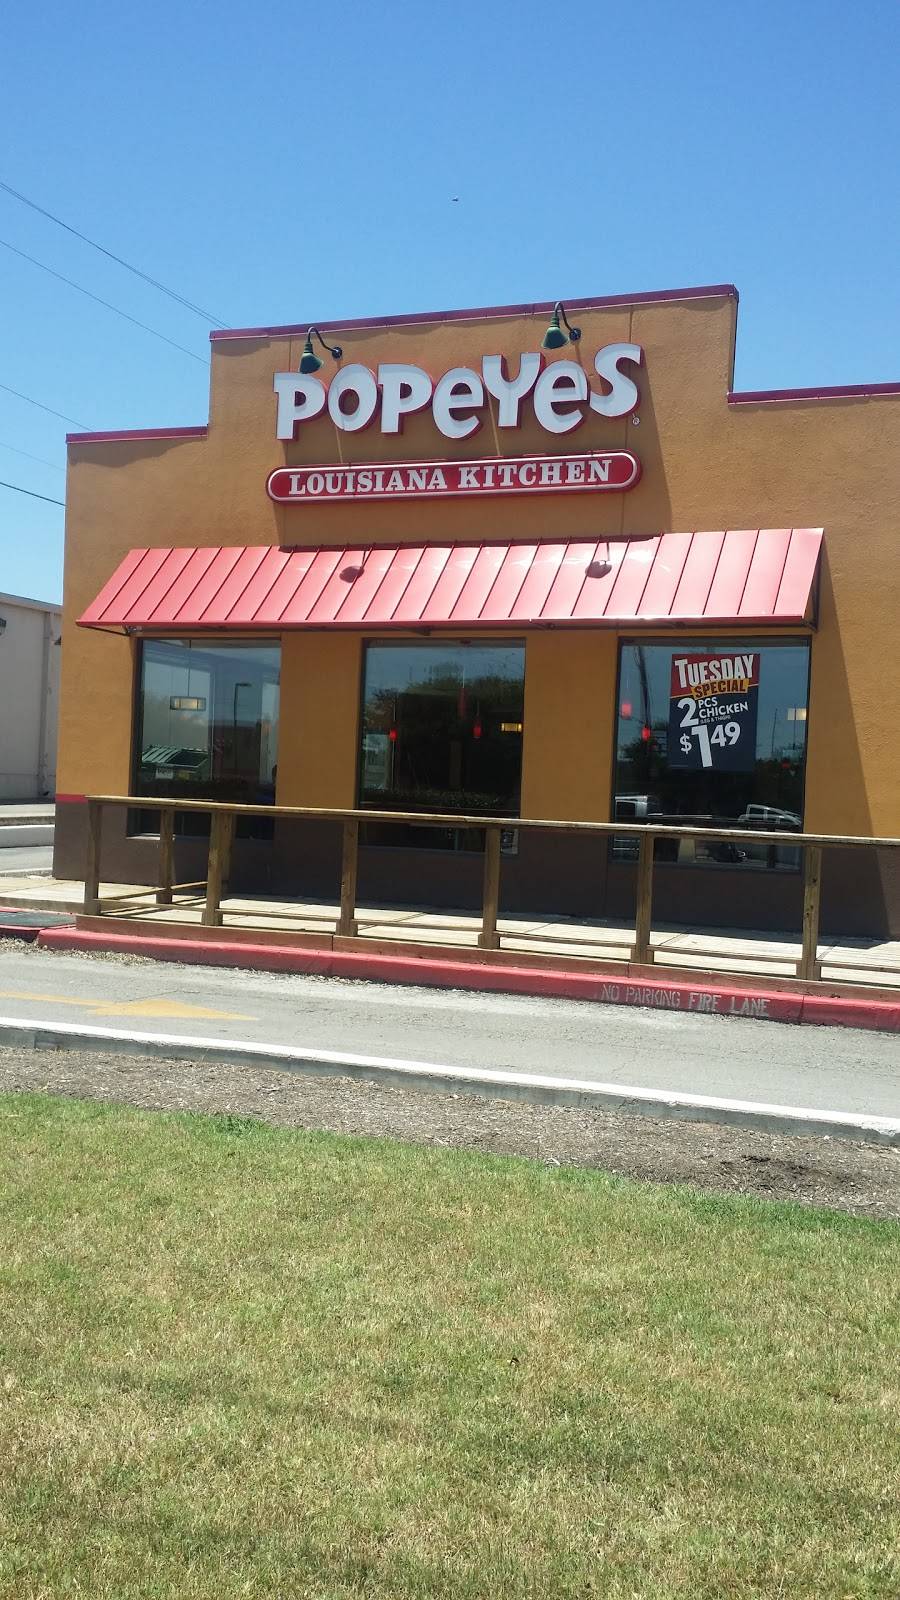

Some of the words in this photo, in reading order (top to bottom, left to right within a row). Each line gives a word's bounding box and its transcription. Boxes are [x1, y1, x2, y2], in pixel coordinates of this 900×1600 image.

[289, 468, 448, 496] LOUISIANA
[458, 459, 612, 489] KITCHEN
[674, 654, 754, 688] TUESDAY
[693, 679, 746, 698] SPECIAL
[677, 697, 699, 728] 2
[698, 696, 718, 708] PCS
[698, 701, 749, 719] CHICKEN
[601, 983, 619, 1001] NO
[625, 985, 681, 1008] PARKING
[688, 992, 722, 1013] FIRE
[729, 996, 771, 1016] LANE
